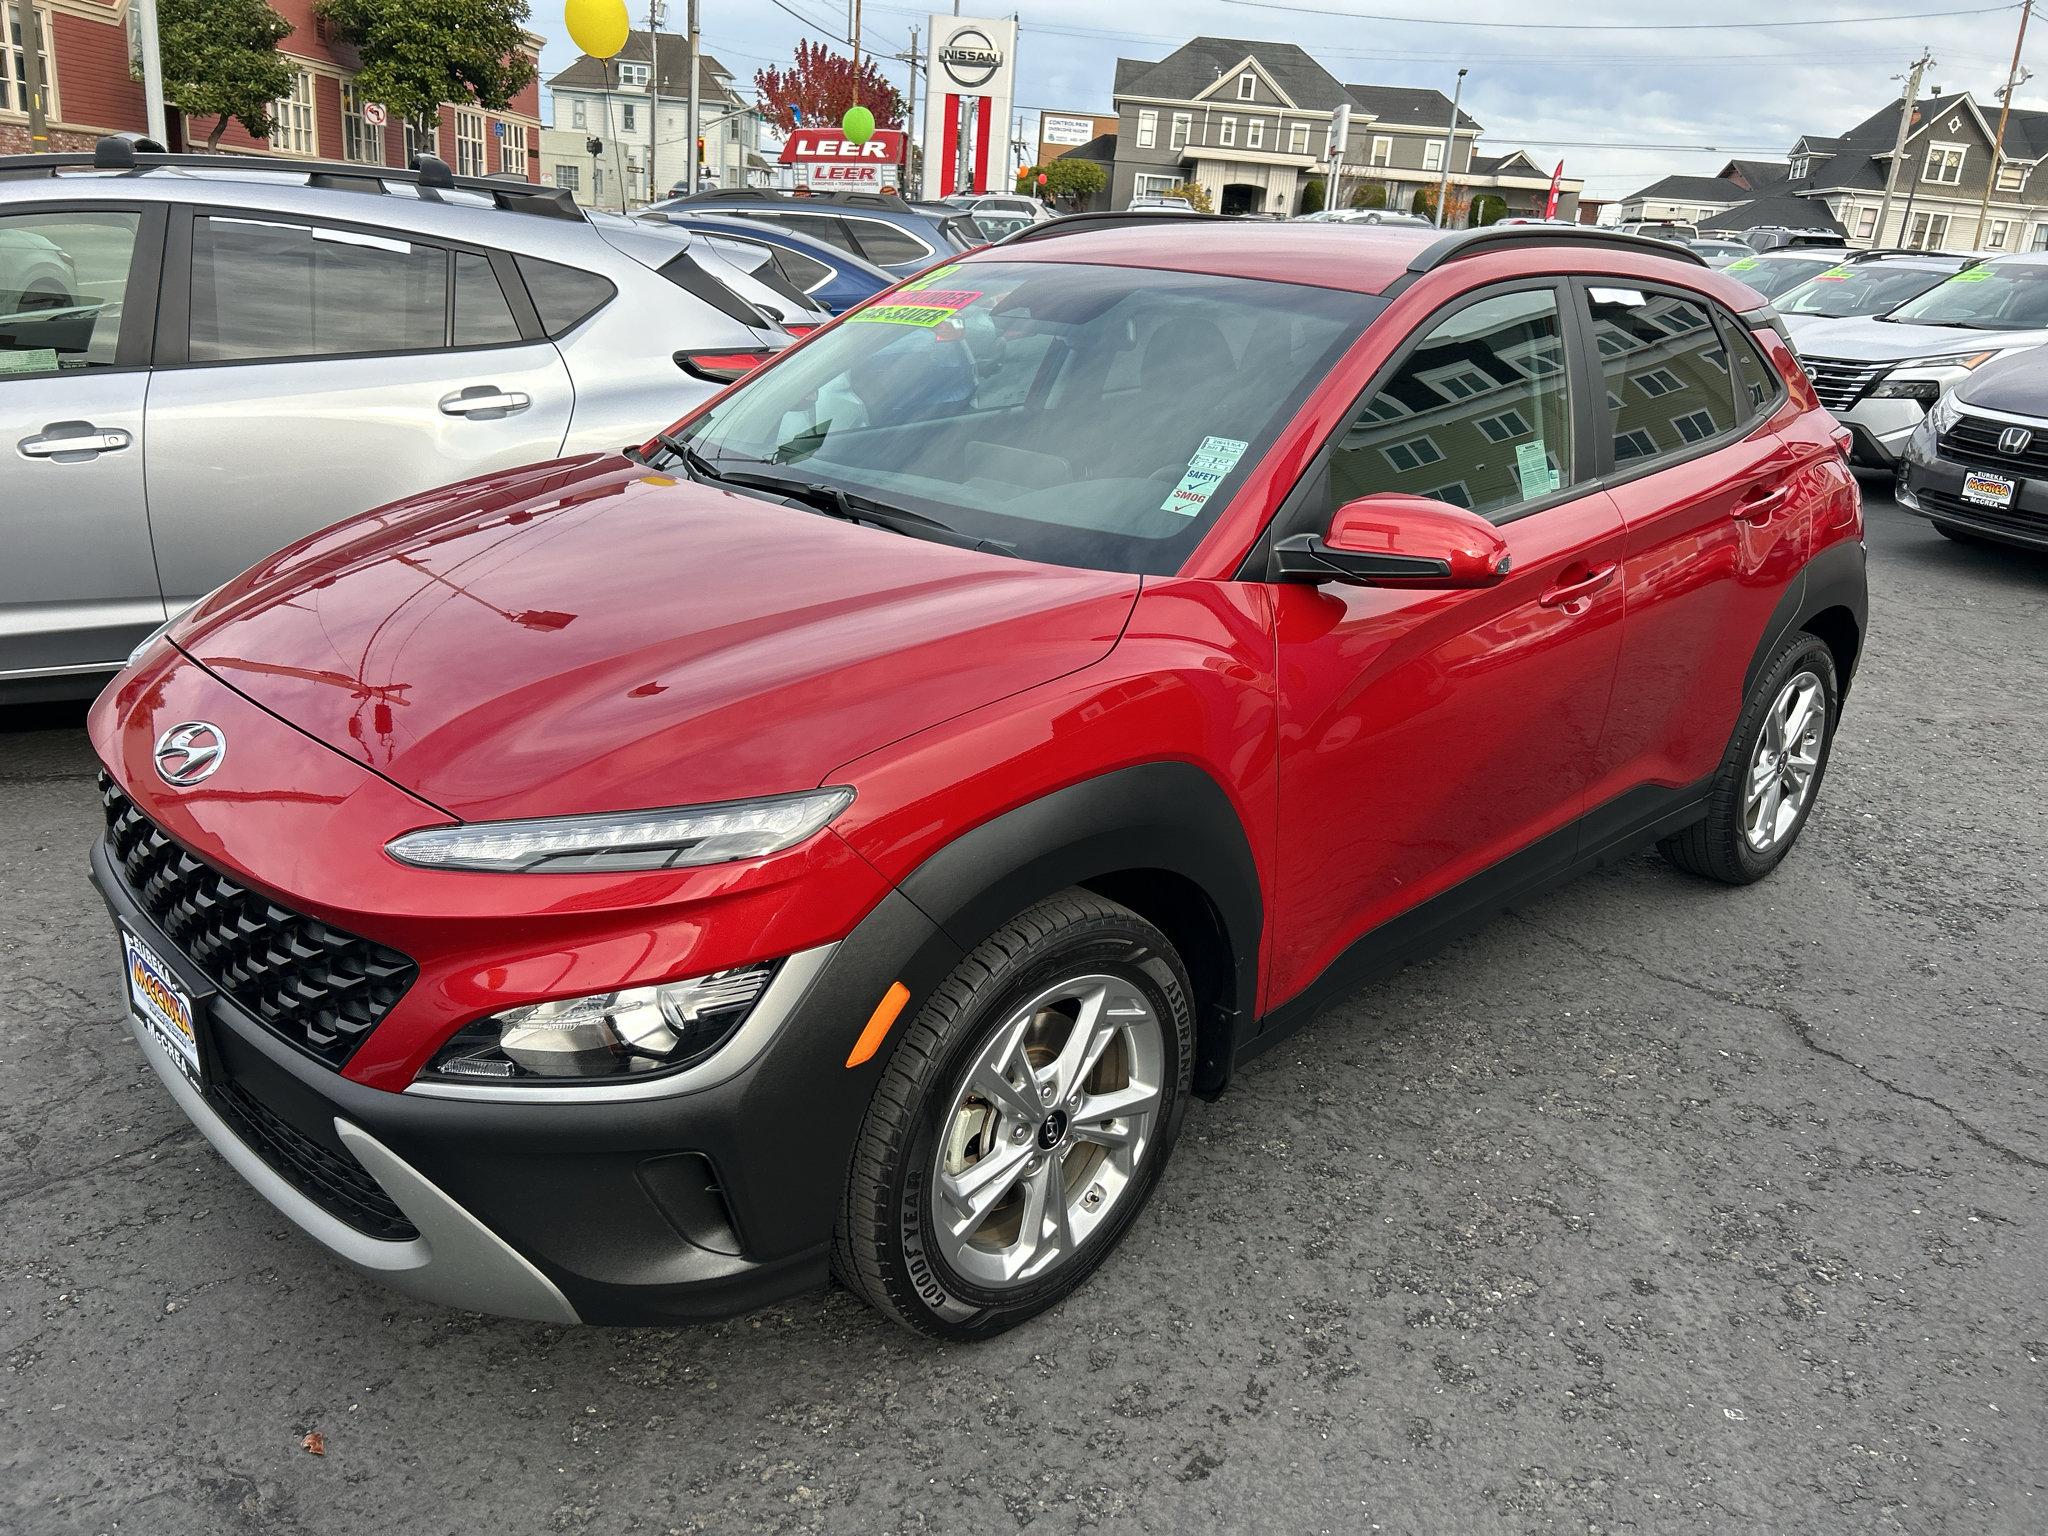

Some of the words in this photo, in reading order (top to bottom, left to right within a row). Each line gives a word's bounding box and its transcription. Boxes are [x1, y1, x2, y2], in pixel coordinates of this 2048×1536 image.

[944, 49, 997, 62] NISSAN
[795, 140, 887, 158] LEER
[814, 166, 877, 180] LEER
[1187, 470, 1221, 483] SAFETY
[1977, 471, 2003, 481] EUREKA
[1173, 490, 1206, 503] SMOG
[132, 935, 173, 985] EUREKA
[903, 1169, 947, 1309] GOODYEAR
